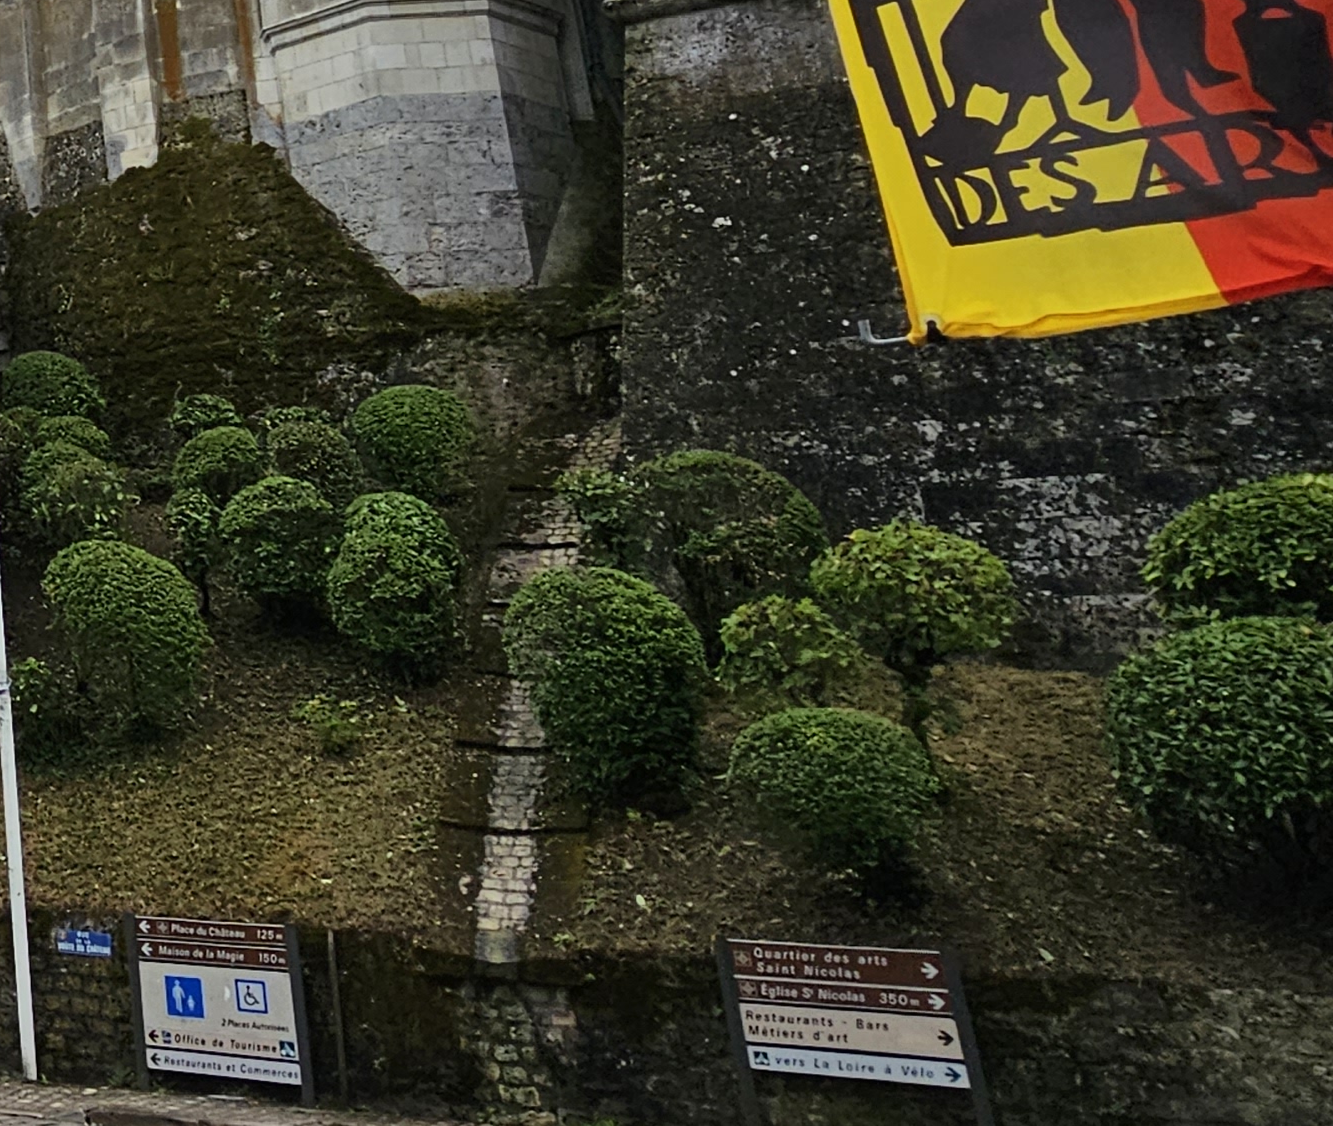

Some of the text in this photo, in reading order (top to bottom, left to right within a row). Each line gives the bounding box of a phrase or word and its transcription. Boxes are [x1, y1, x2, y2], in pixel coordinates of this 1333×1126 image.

[936, 154, 1098, 229] DES
[171, 924, 195, 935] Place
[196, 927, 208, 936] du
[209, 927, 246, 940] Château
[158, 945, 190, 957] Maison
[192, 948, 204, 958] de
[206, 949, 215, 959] la
[216, 950, 245, 963] Magie
[753, 946, 888, 967] Quartier des arts
[756, 961, 861, 980] Saint Nicolas
[760, 983, 798, 999] Église
[818, 988, 866, 1003] Nicolas
[745, 1009, 834, 1027] Restaurants
[856, 1018, 890, 1032] Bars
[174, 1033, 278, 1053] Office de Tourisme
[748, 1025, 804, 1041] Métiers
[164, 1055, 299, 1079] Restaurants et Commerces
[775, 1057, 806, 1068] vers
[813, 1058, 830, 1070] La
[838, 1060, 875, 1074] Loire
[901, 1065, 935, 1079] Vélo
